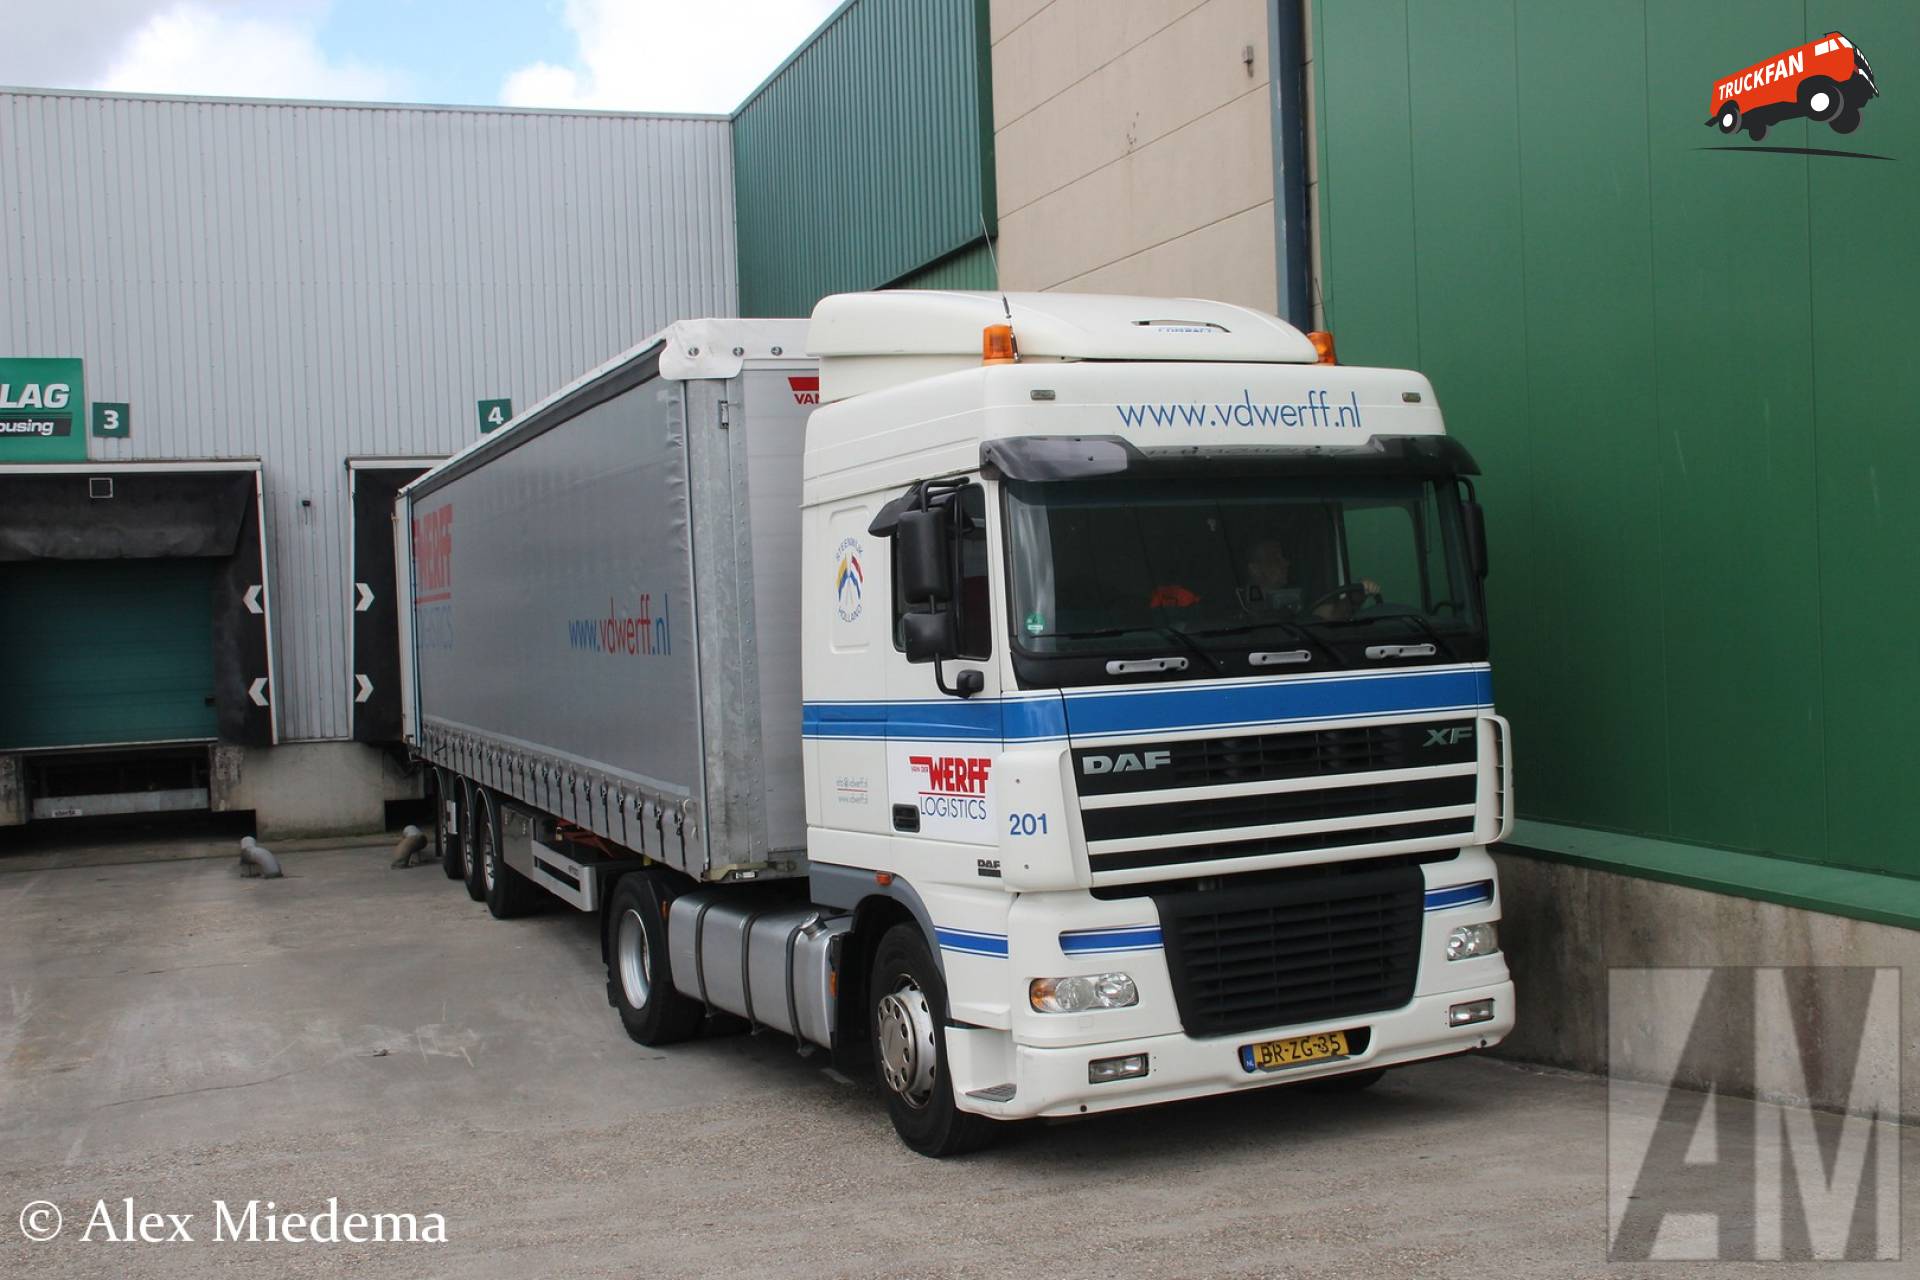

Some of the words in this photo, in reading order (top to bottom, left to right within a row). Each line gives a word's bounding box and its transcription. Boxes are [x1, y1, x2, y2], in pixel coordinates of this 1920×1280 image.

[103, 409, 119, 430] 3
[487, 406, 504, 425] 4
[1116, 389, 1361, 428] www.vdwerff.nl
[568, 591, 672, 657] www.vdwerff.nl
[1422, 725, 1472, 747] XF
[1082, 750, 1171, 775] DAF
[929, 756, 992, 794] WERFF
[920, 796, 987, 820] LOGISTICS
[1009, 813, 1048, 836] 201
[1260, 1034, 1342, 1065] BR-ZG-35
